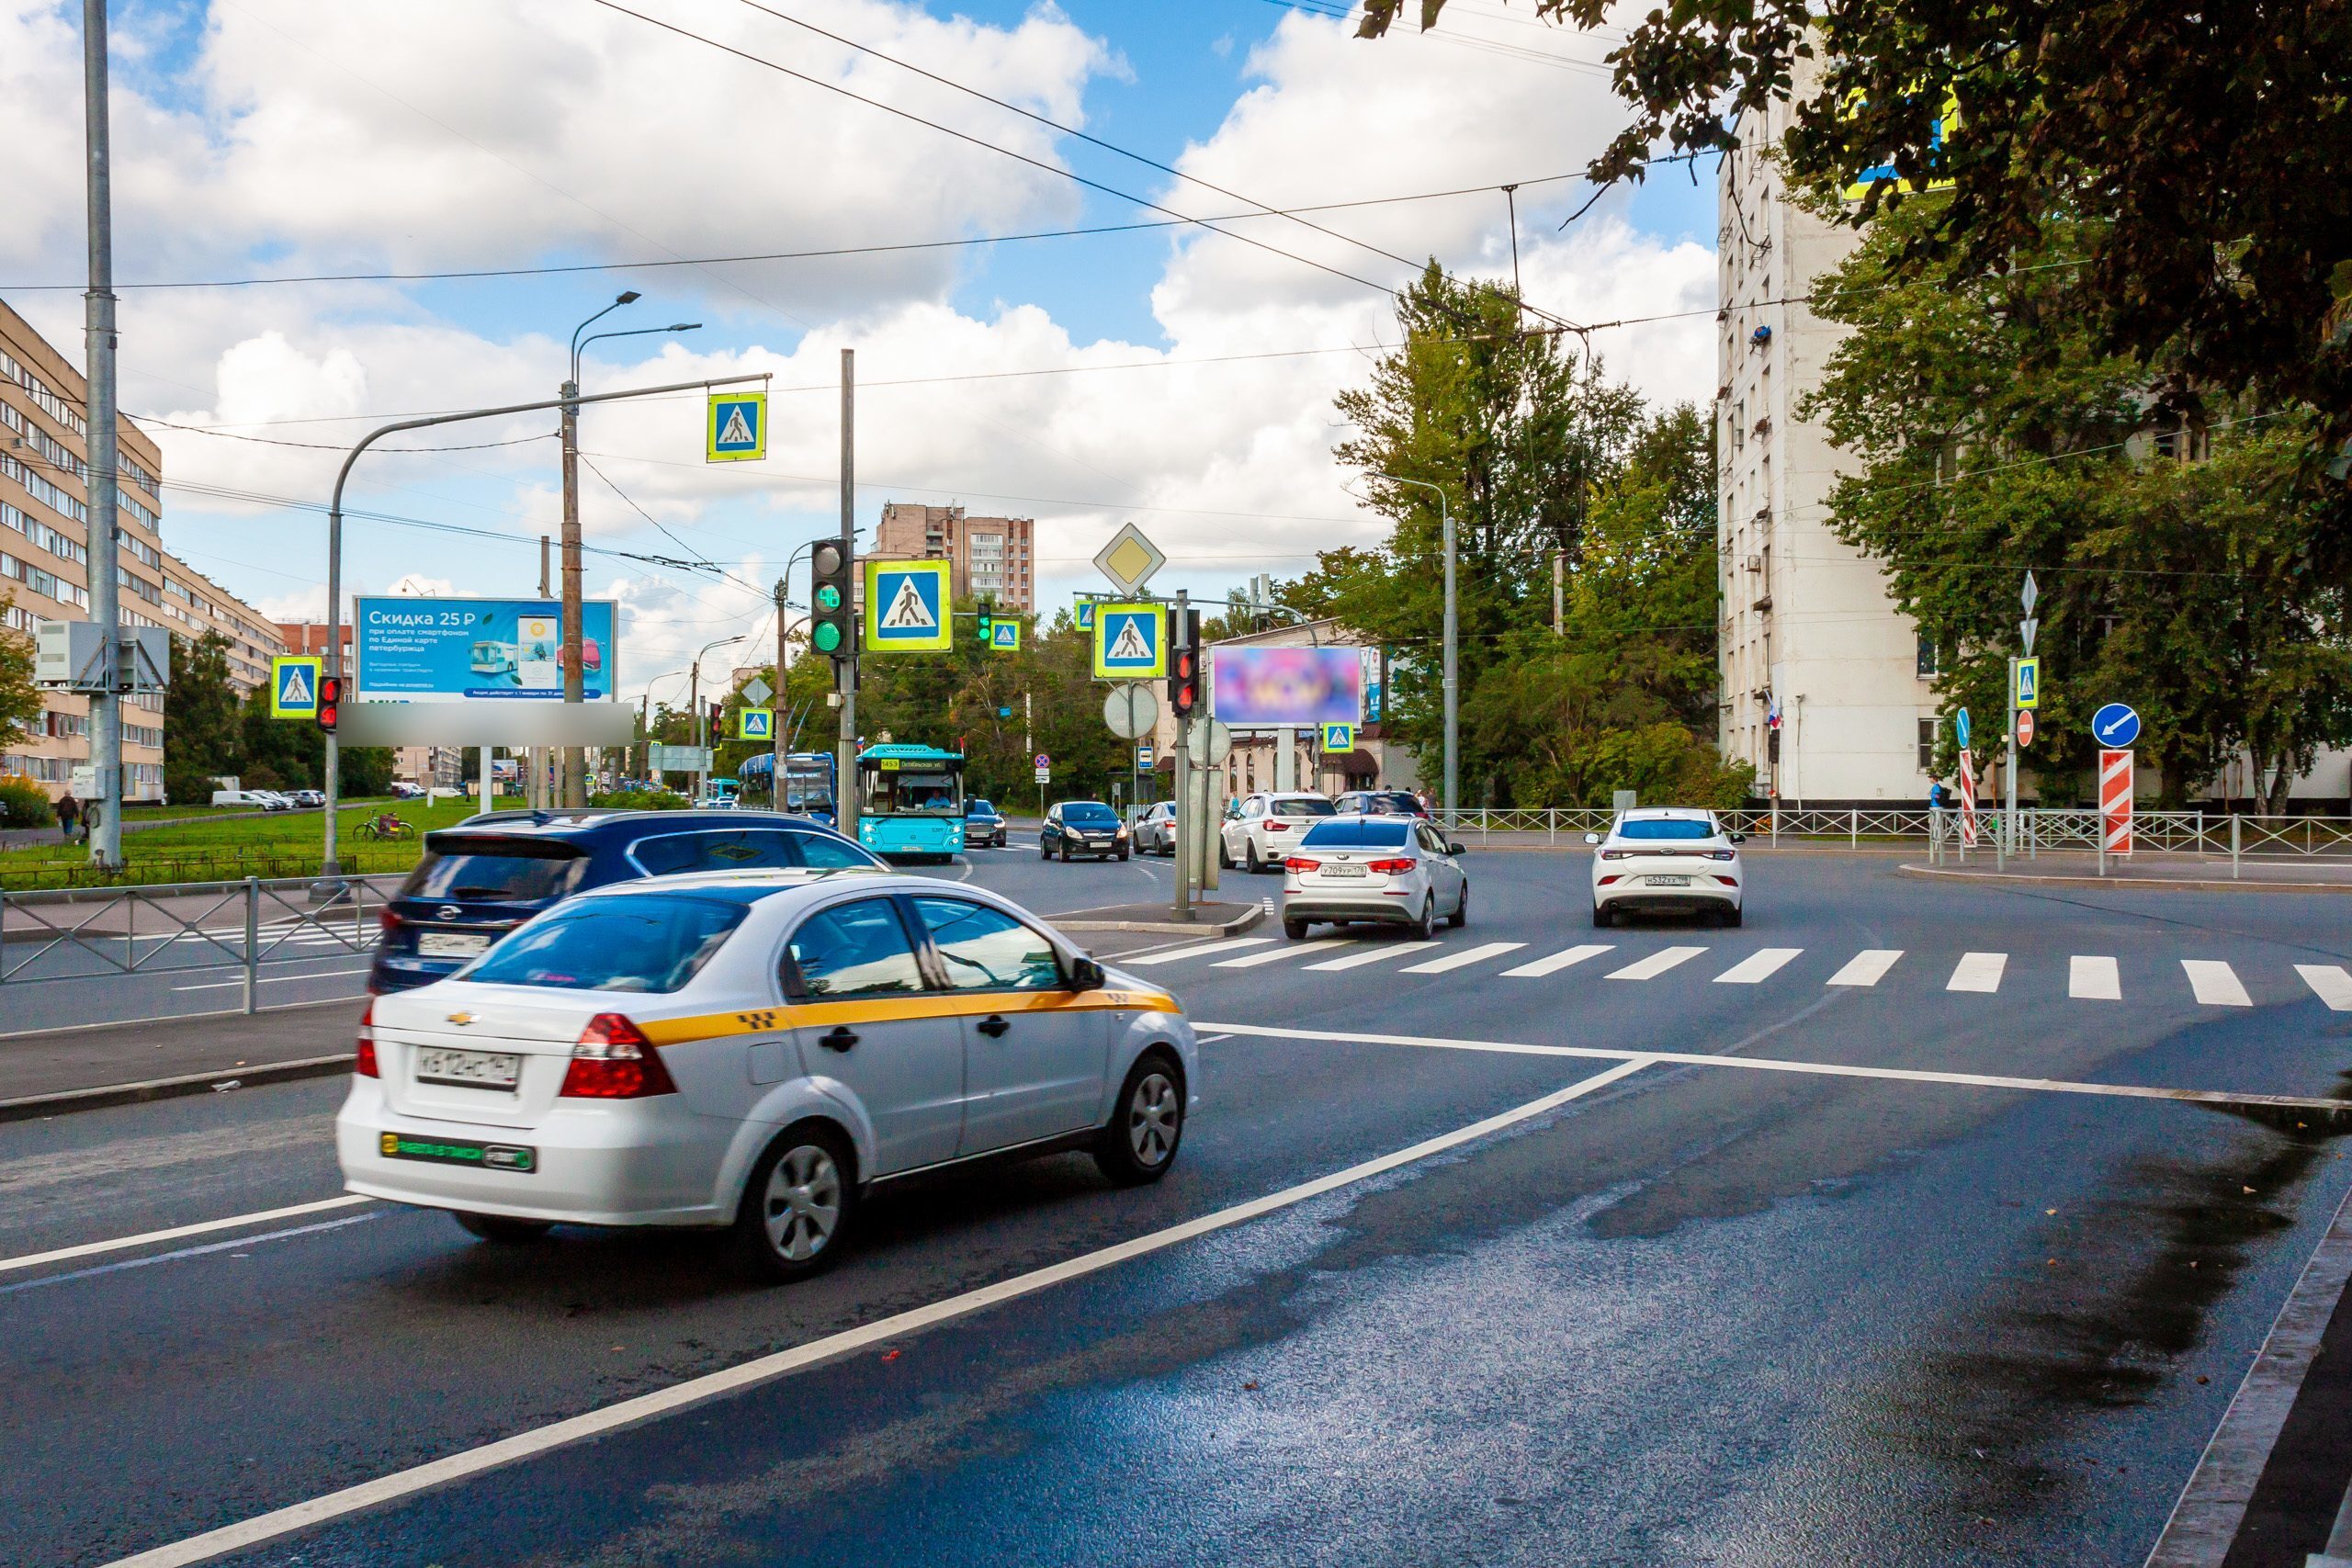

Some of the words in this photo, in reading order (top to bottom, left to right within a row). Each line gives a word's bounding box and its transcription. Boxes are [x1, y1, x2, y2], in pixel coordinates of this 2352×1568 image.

[369, 611, 434, 626] Скидка
[440, 613, 459, 626] 25
[1323, 866, 1351, 874] У709УР
